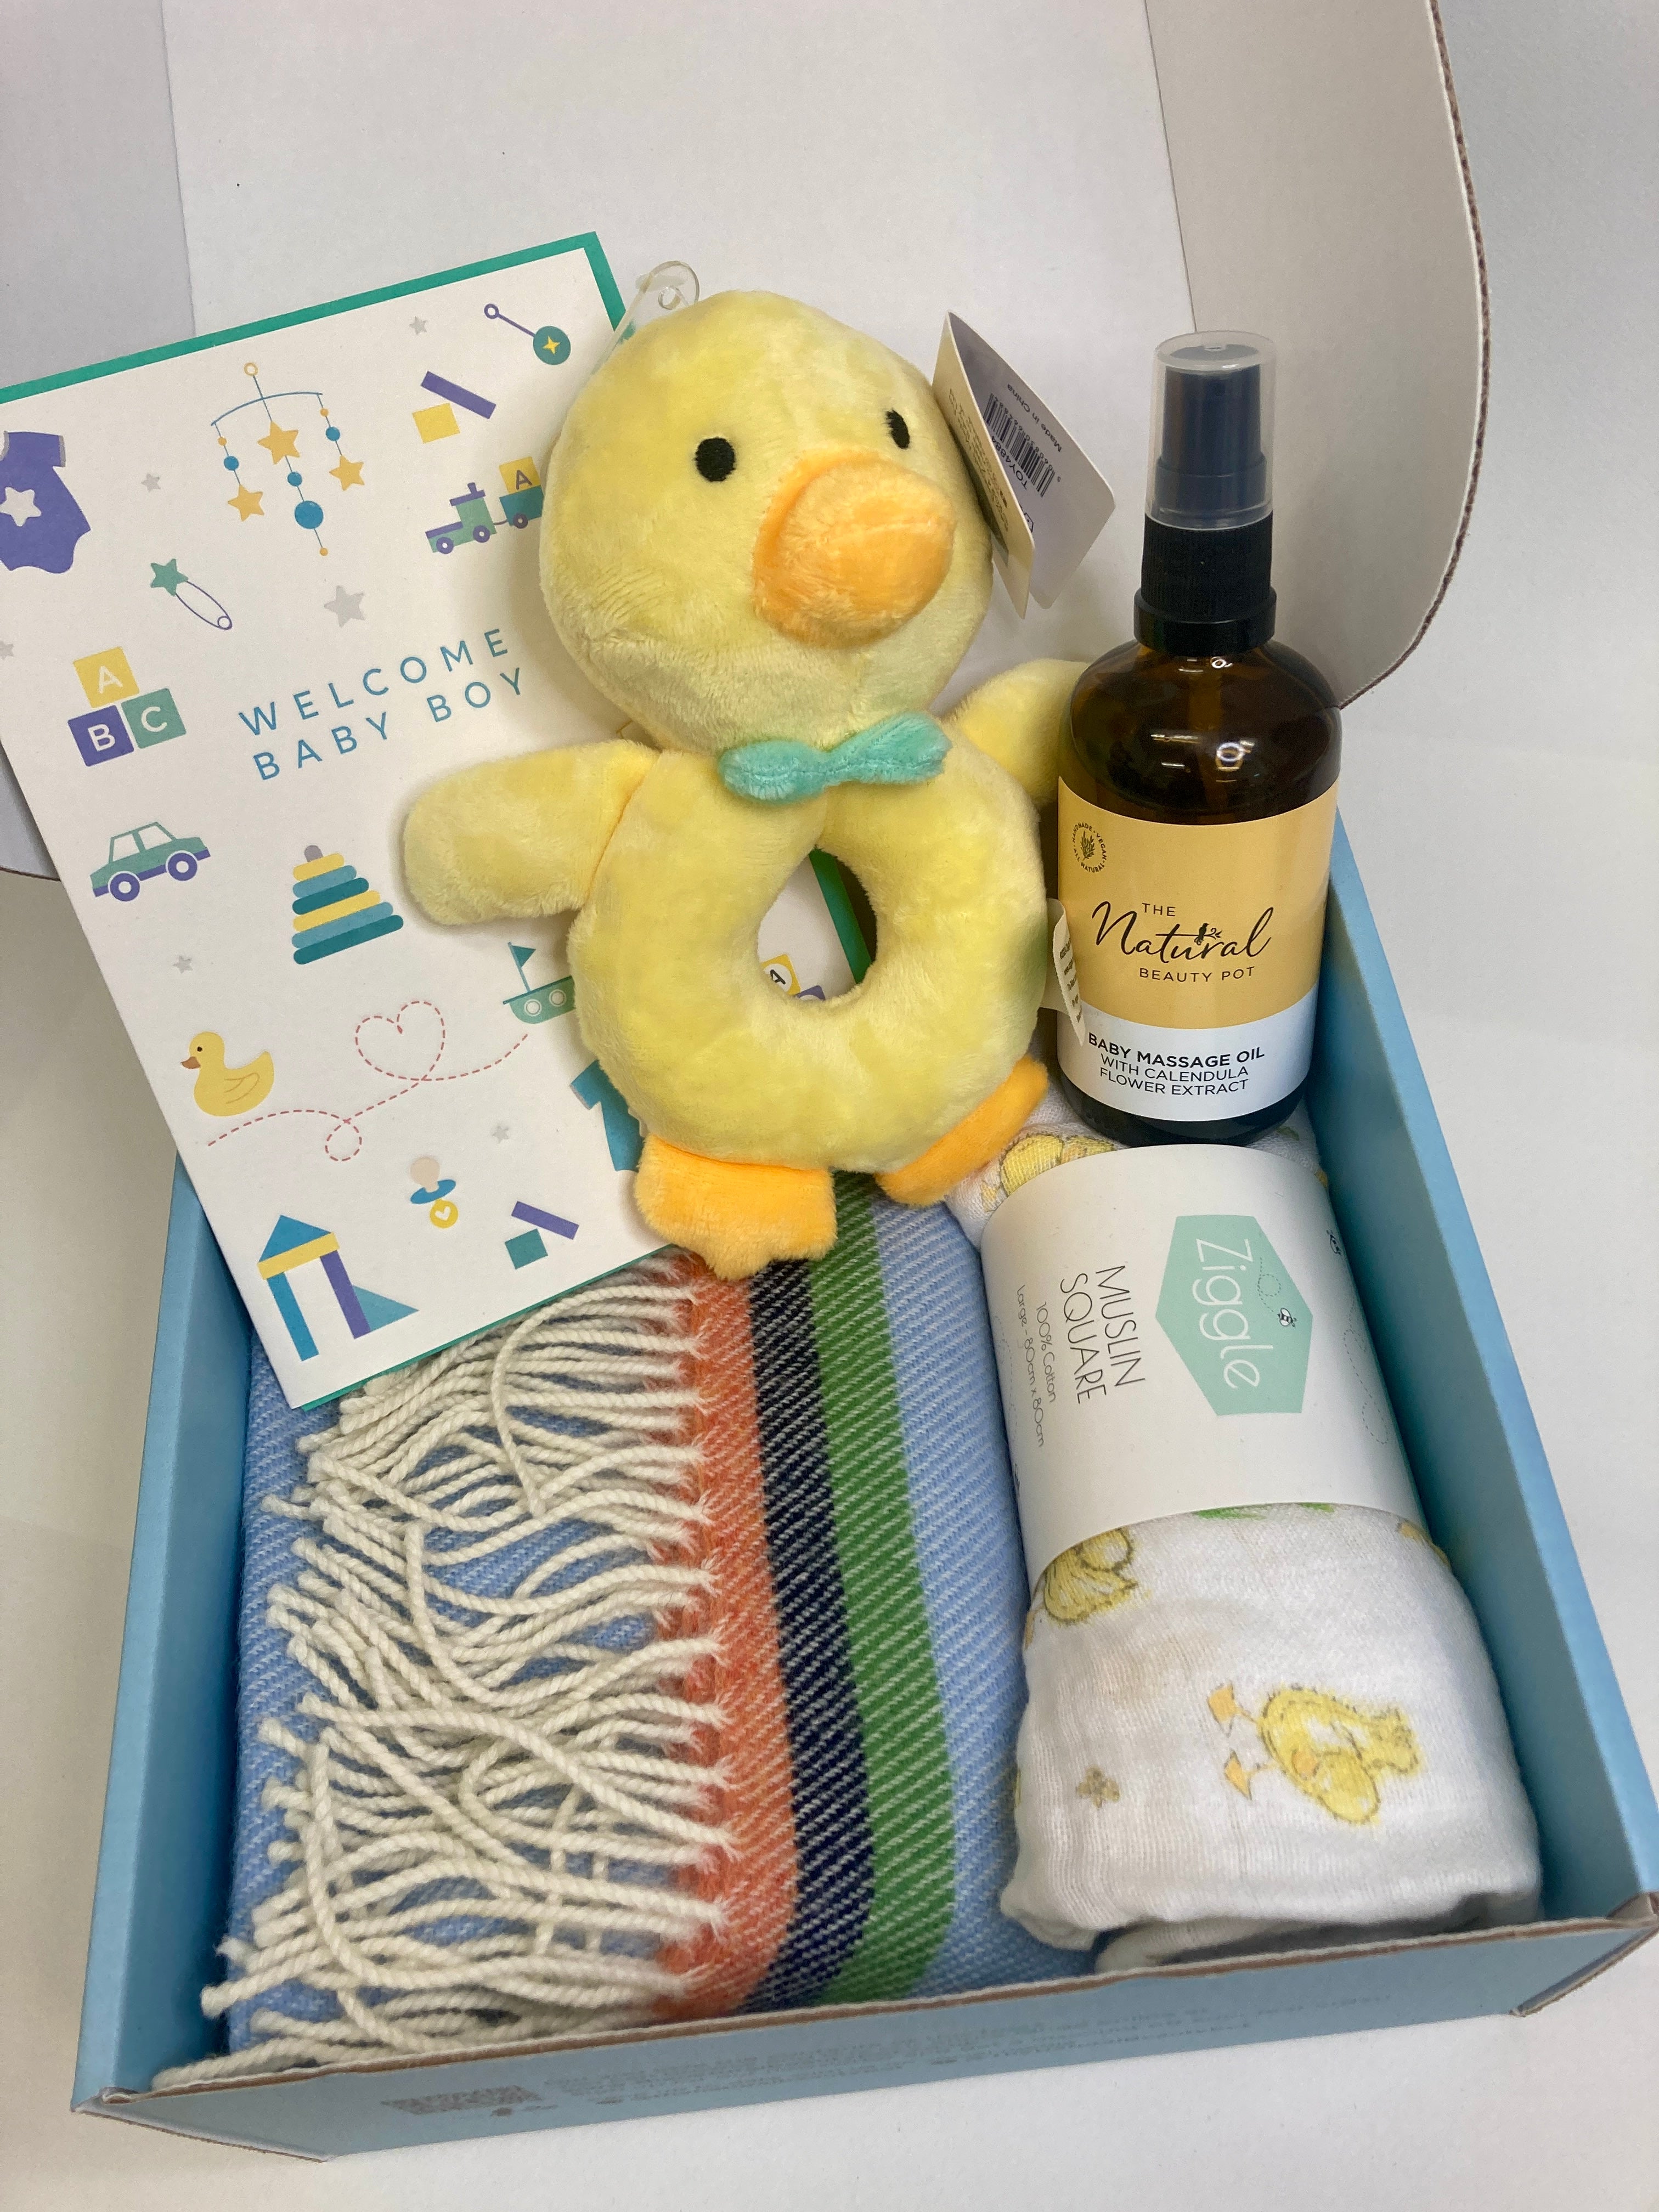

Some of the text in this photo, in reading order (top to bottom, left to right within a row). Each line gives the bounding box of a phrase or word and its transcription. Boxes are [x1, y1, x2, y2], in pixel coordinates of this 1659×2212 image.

[1007, 384, 1062, 452] Made in China
[516, 470, 532, 490] A
[991, 436, 1028, 490] TOY4884
[97, 665, 123, 694] A
[238, 629, 508, 736] WELCOME
[88, 706, 167, 752] B C
[253, 667, 521, 781] BABY BOY
[1081, 862, 1105, 873] NATURAL
[1096, 832, 1107, 860] VEGAN
[1092, 901, 1273, 963] Natural
[1142, 902, 1176, 917] THE
[1139, 966, 1255, 983] BEAUTY POT
[1088, 1032, 1265, 1068] BABY MASSAGE OIL
[1101, 1053, 1249, 1082] WITH CALENDULA
[1100, 1067, 1249, 1096] FLOWER EXTRACT
[1060, 1273, 1107, 1404] SQUARE
[1095, 1265, 1146, 1387] MUSLIN
[1192, 1238, 1273, 1389] Ziggle
[1017, 1285, 1028, 1327] Large
[1024, 1338, 1036, 1385] 80cm
[1033, 1397, 1044, 1448] 80cm
[1036, 1301, 1056, 1403] 100% Cotton
